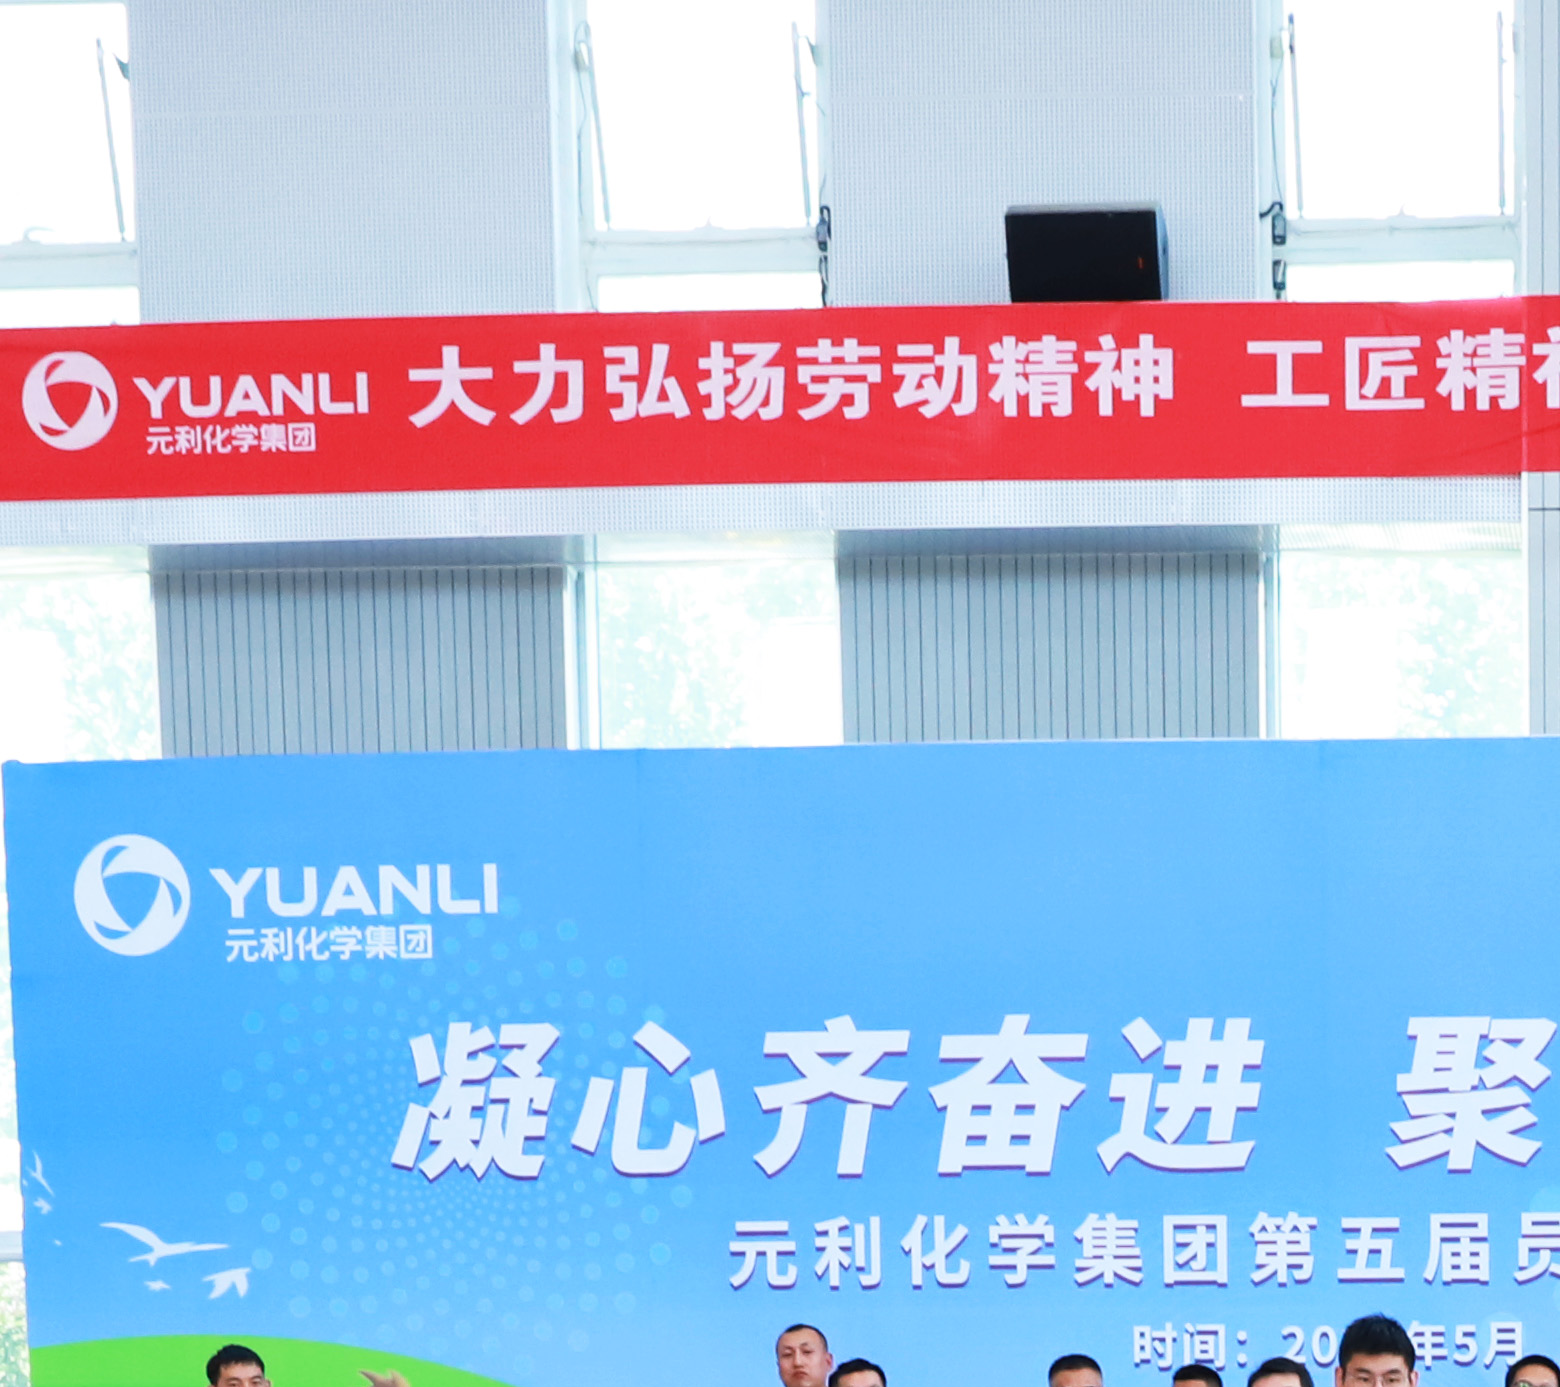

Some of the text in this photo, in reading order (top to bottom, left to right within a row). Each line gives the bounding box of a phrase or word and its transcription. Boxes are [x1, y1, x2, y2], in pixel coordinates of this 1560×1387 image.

[133, 371, 369, 419] YUANLI
[409, 334, 1174, 428] 大力弘扬劳动精神
[146, 423, 317, 455] 元利化学集团
[209, 863, 499, 919] YUANLI
[225, 923, 433, 963] 元利化学集团
[389, 1013, 1260, 1180] 凝心齐奋进
[1133, 1320, 1523, 1372] 时间：20年5月
